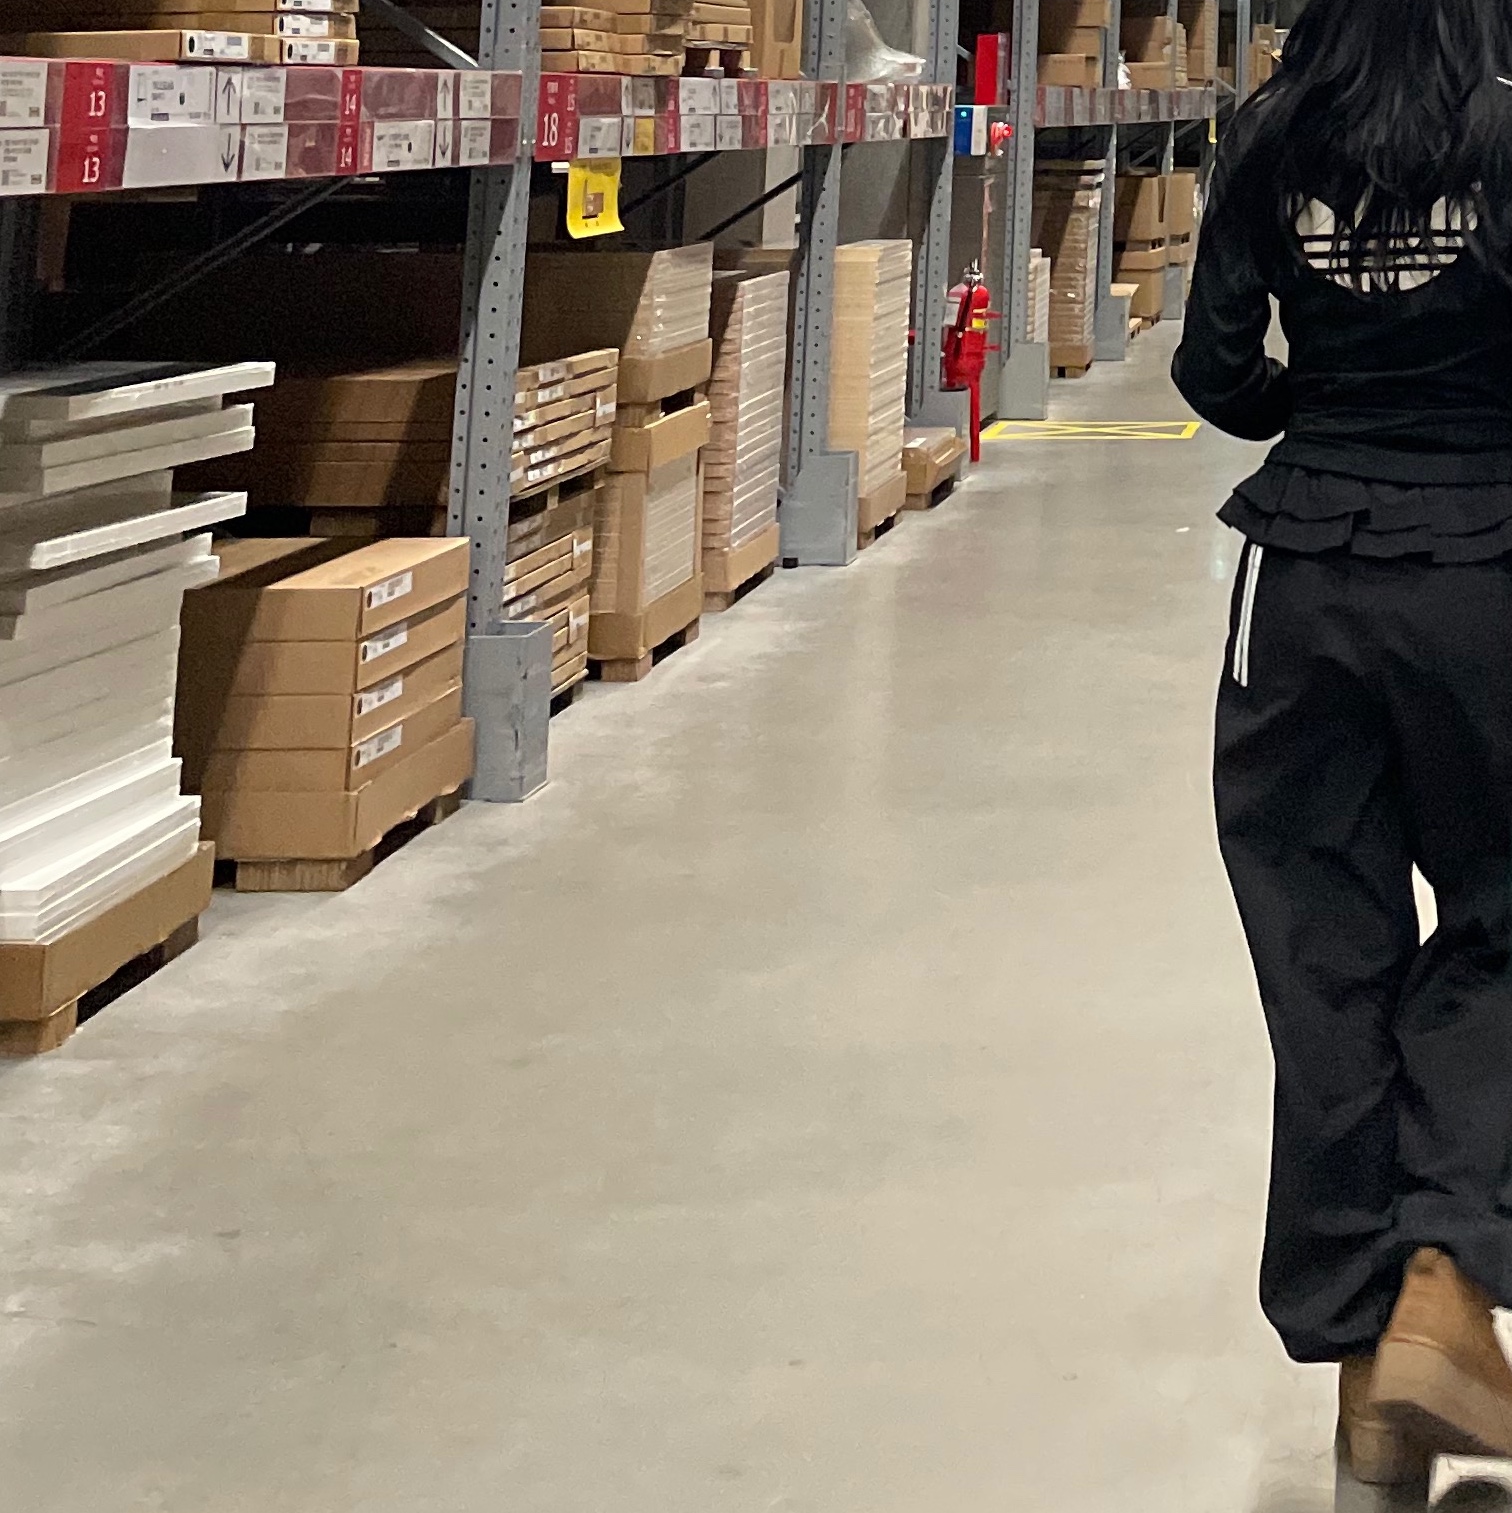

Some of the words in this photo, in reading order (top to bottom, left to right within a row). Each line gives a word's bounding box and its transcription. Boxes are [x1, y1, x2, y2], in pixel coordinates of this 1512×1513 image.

[89, 91, 106, 117] 13
[345, 95, 356, 115] 14
[542, 112, 559, 147] 18
[82, 157, 100, 183] 13
[340, 148, 352, 168] 14
